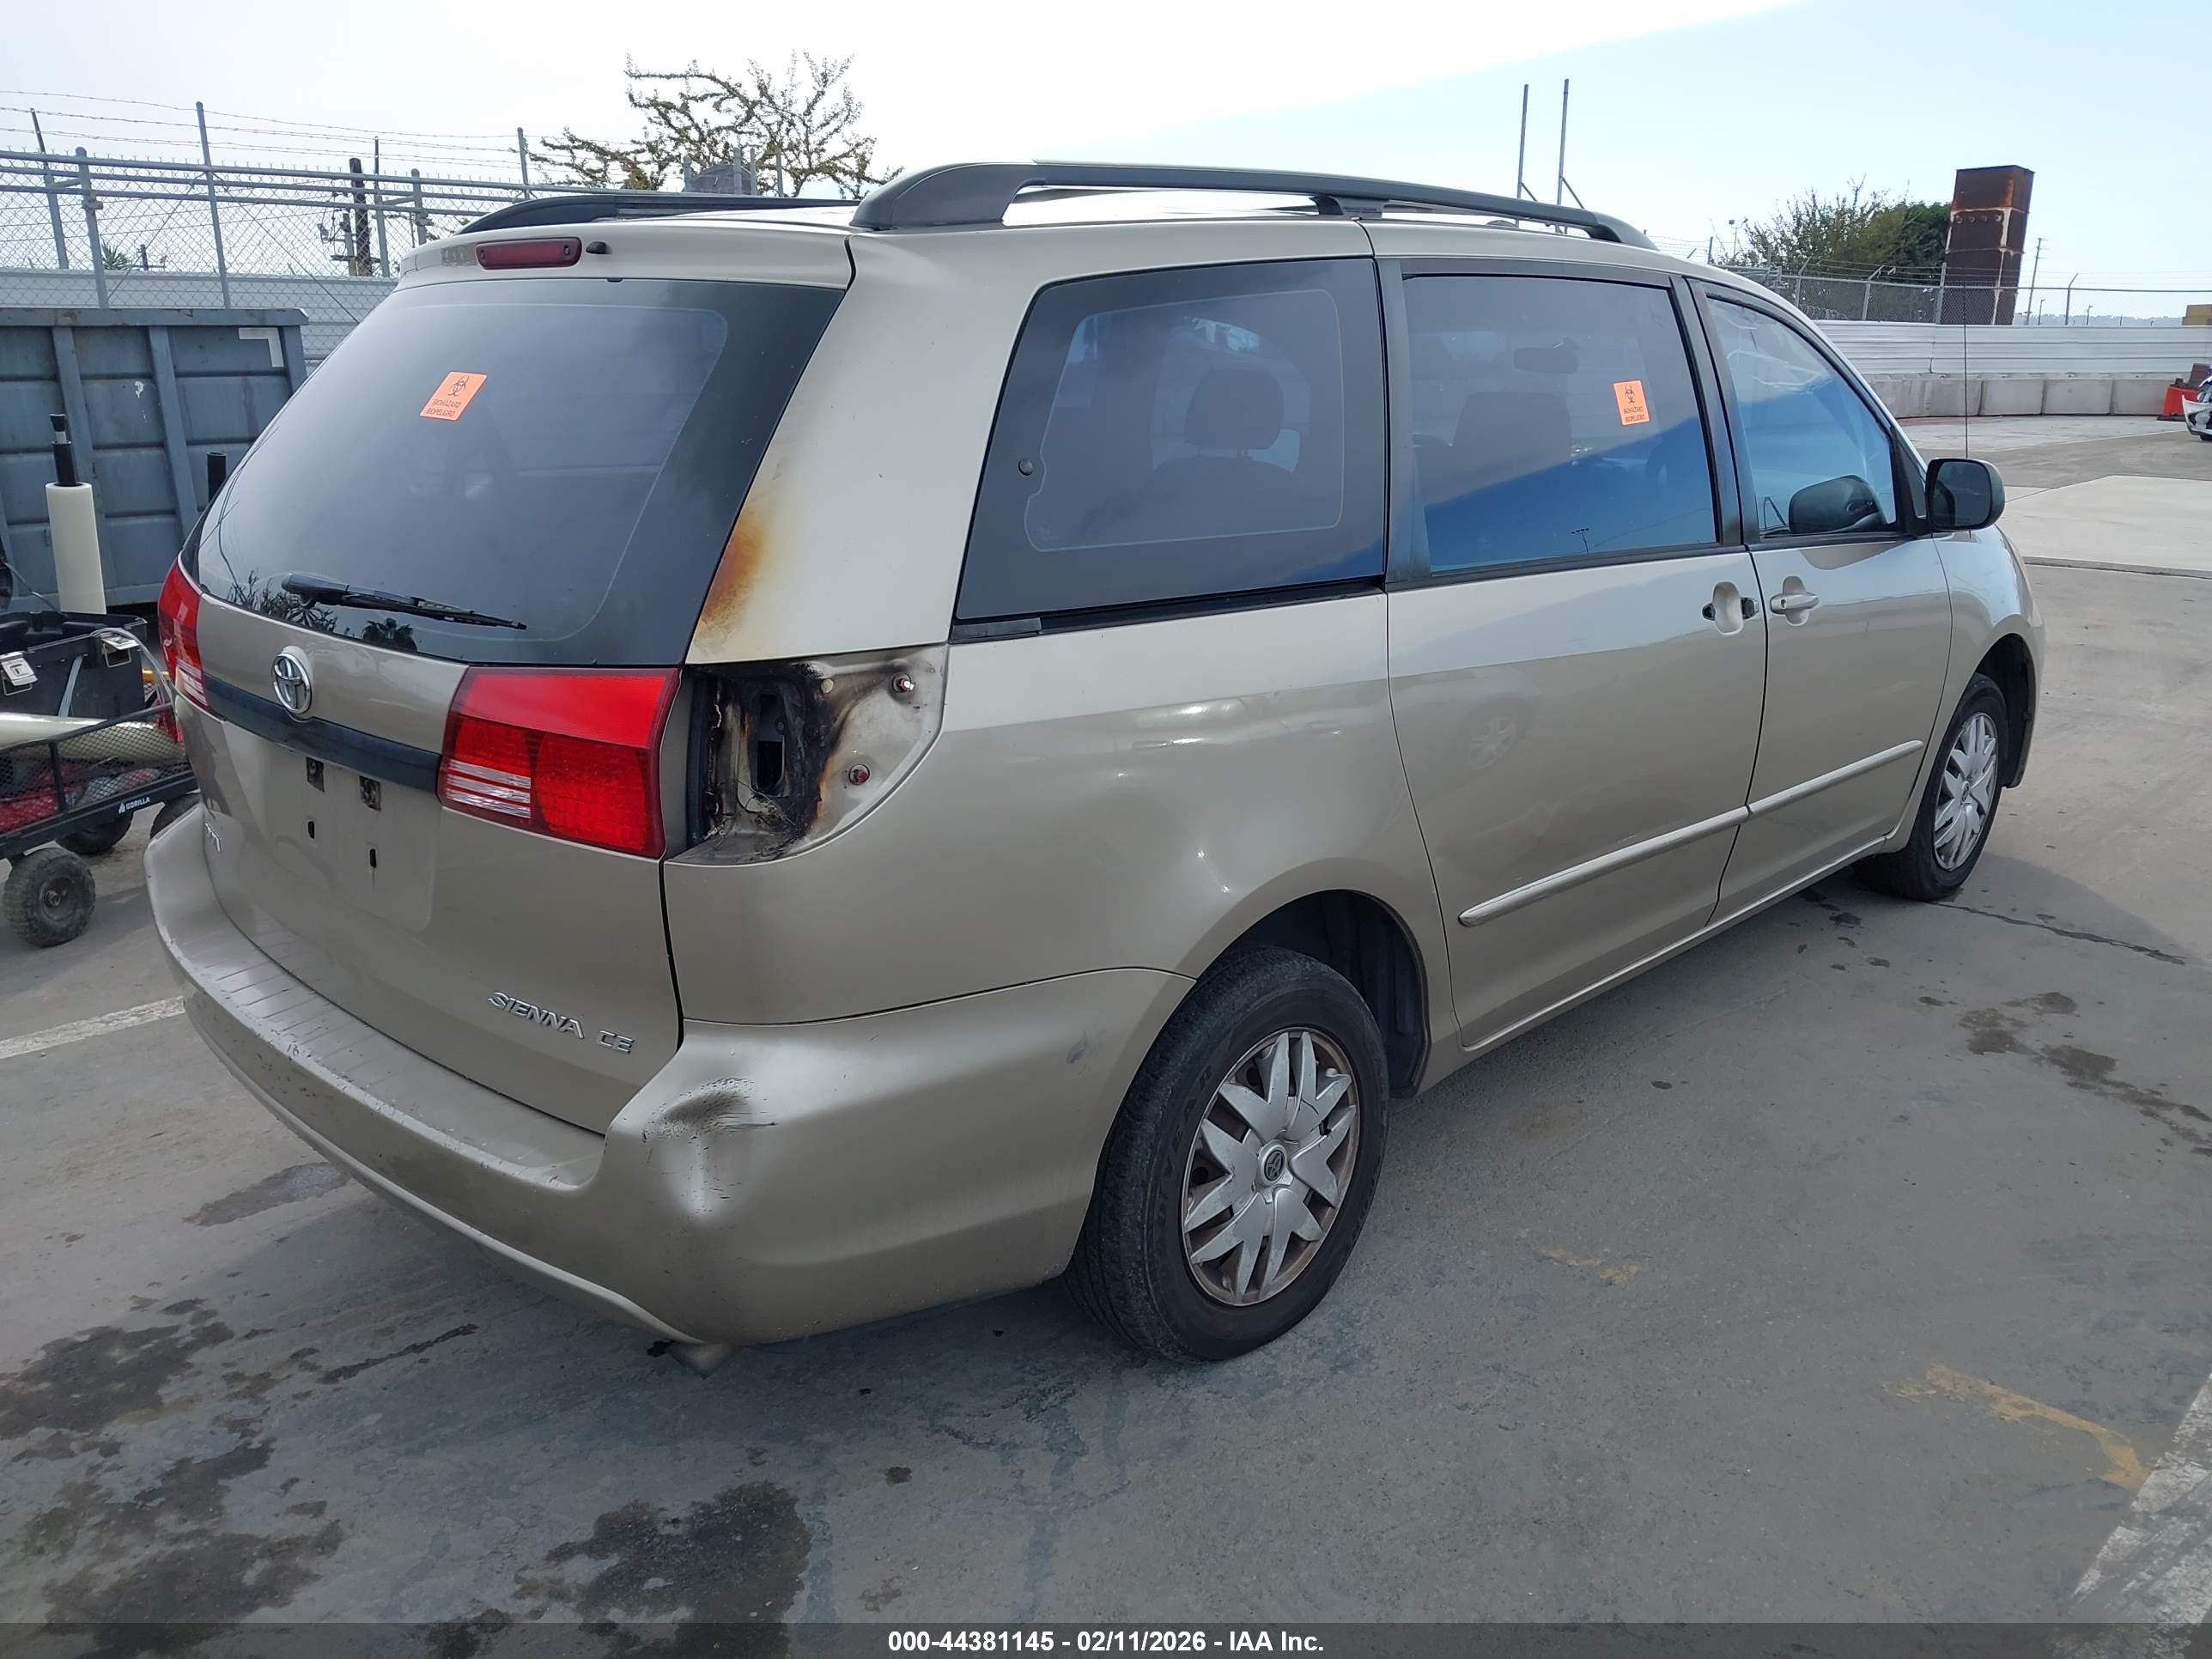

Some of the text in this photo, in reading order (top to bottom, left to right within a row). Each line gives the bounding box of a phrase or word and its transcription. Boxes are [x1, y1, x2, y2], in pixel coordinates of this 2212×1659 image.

[125, 796, 150, 810] GORILLA
[488, 990, 635, 1054] SIENNA CE
